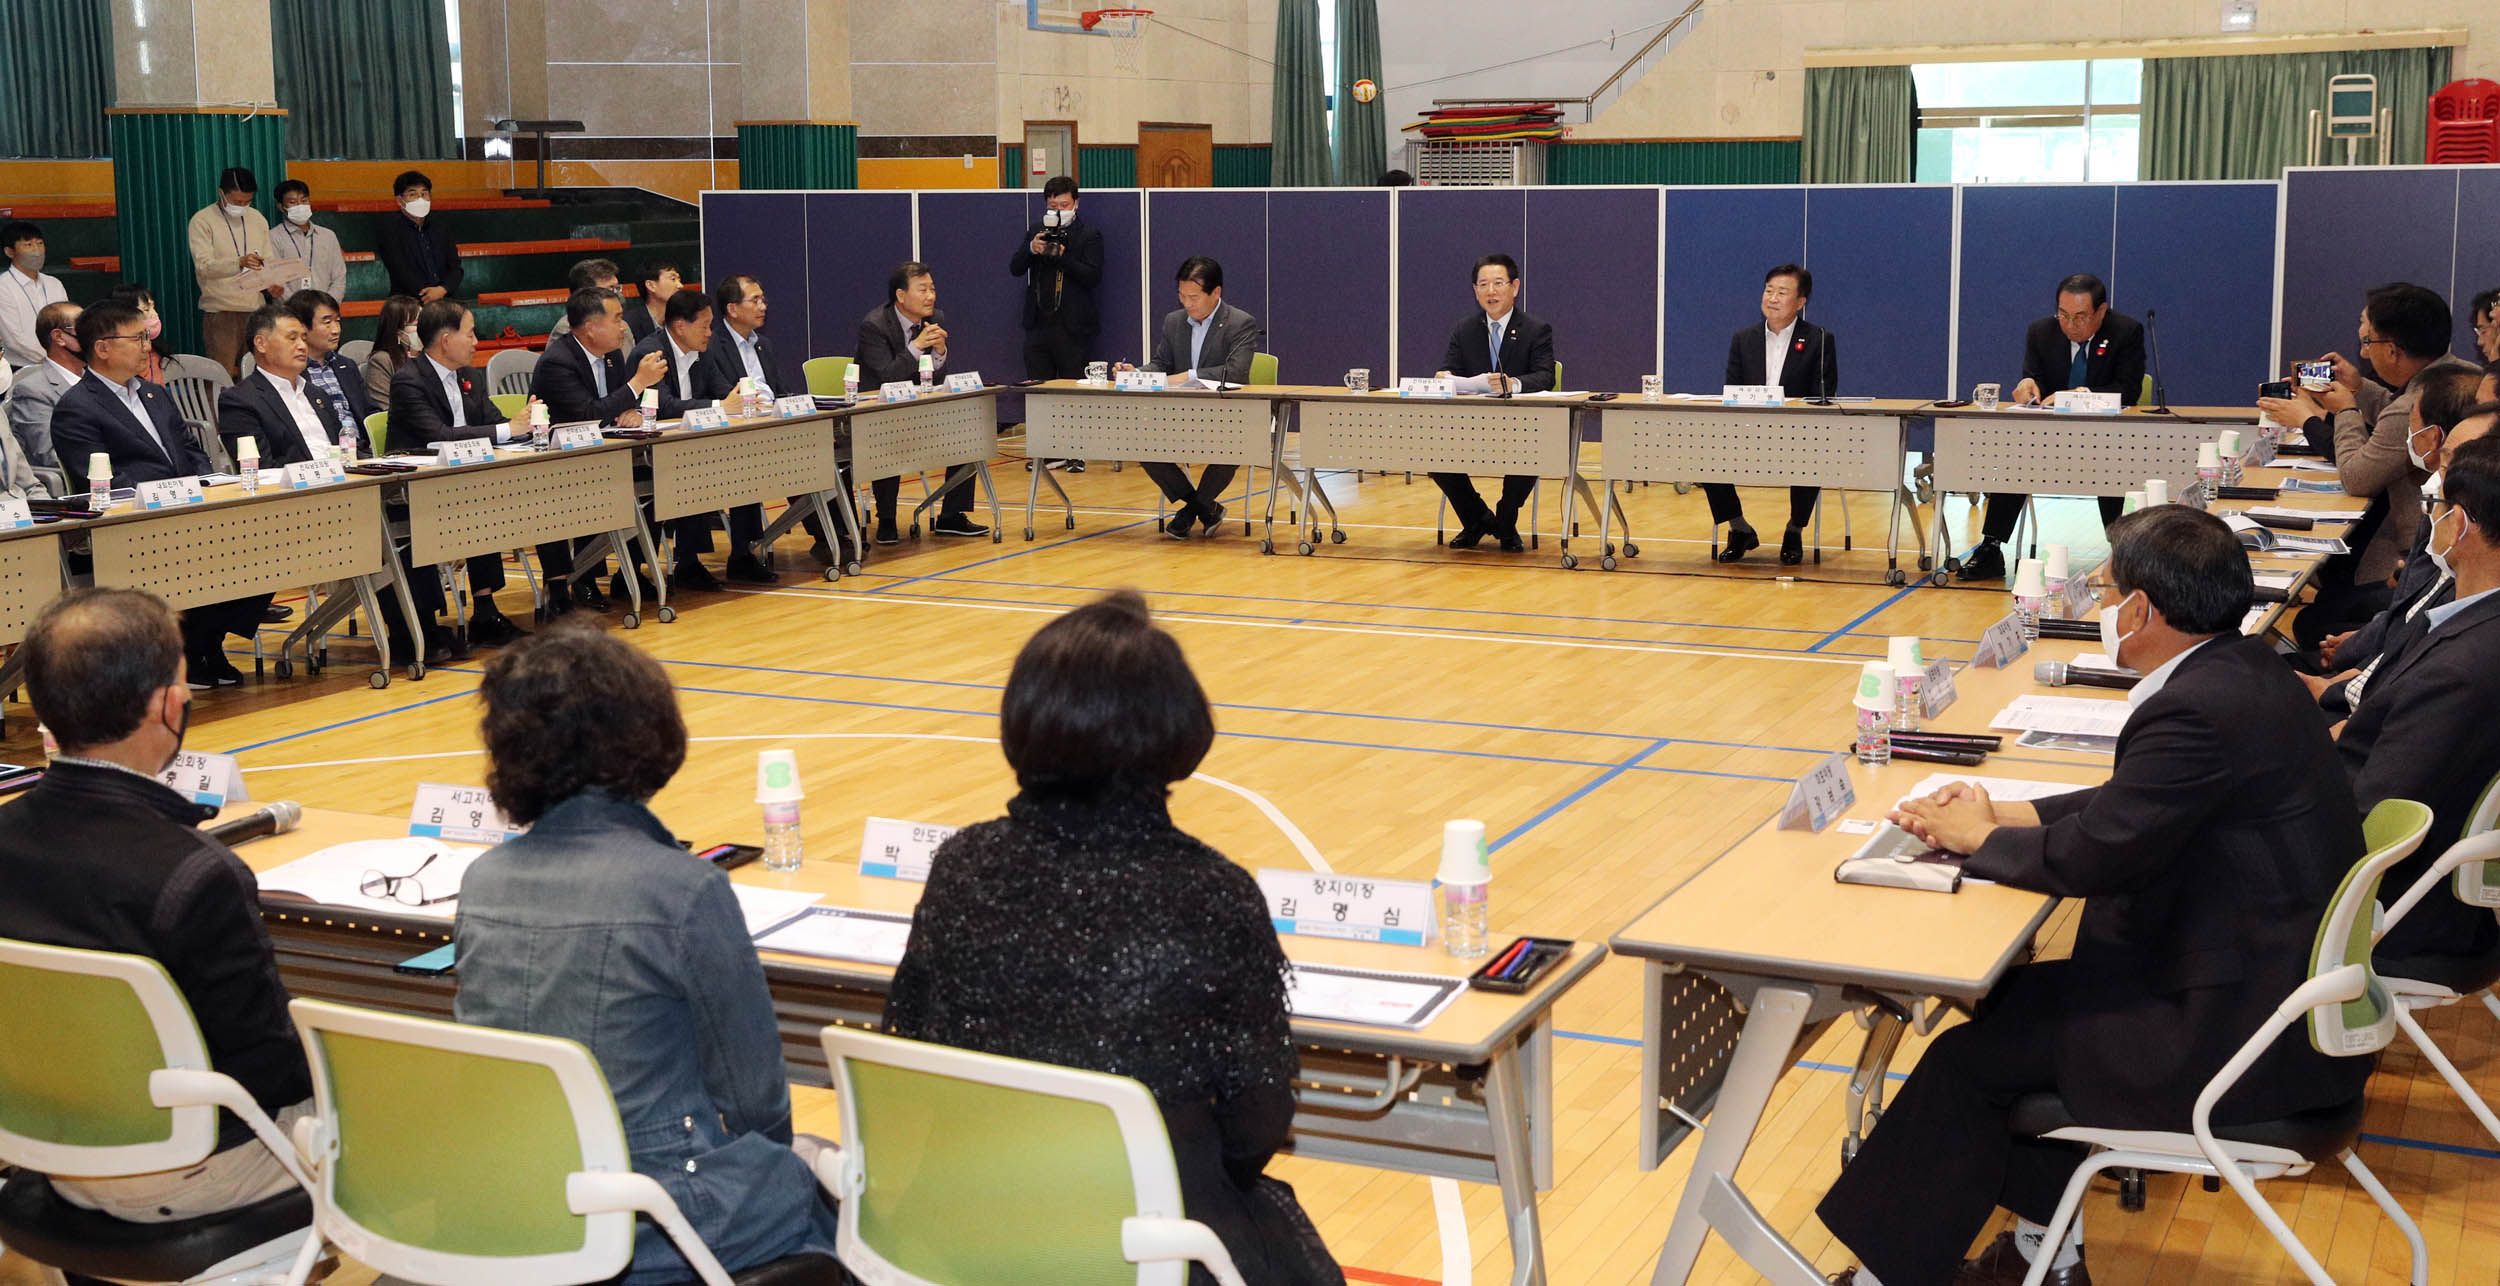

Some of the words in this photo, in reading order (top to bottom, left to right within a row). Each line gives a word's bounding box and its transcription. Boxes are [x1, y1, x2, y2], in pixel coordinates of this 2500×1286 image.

[199, 775, 211, 791] 길
[431, 807, 445, 824] 김
[470, 810, 482, 828] 영
[885, 845, 900, 862] 박
[1313, 879, 1375, 899] 장지이장
[1281, 897, 1297, 916] 김
[1333, 902, 1348, 922] 명
[1384, 907, 1400, 926] 심
